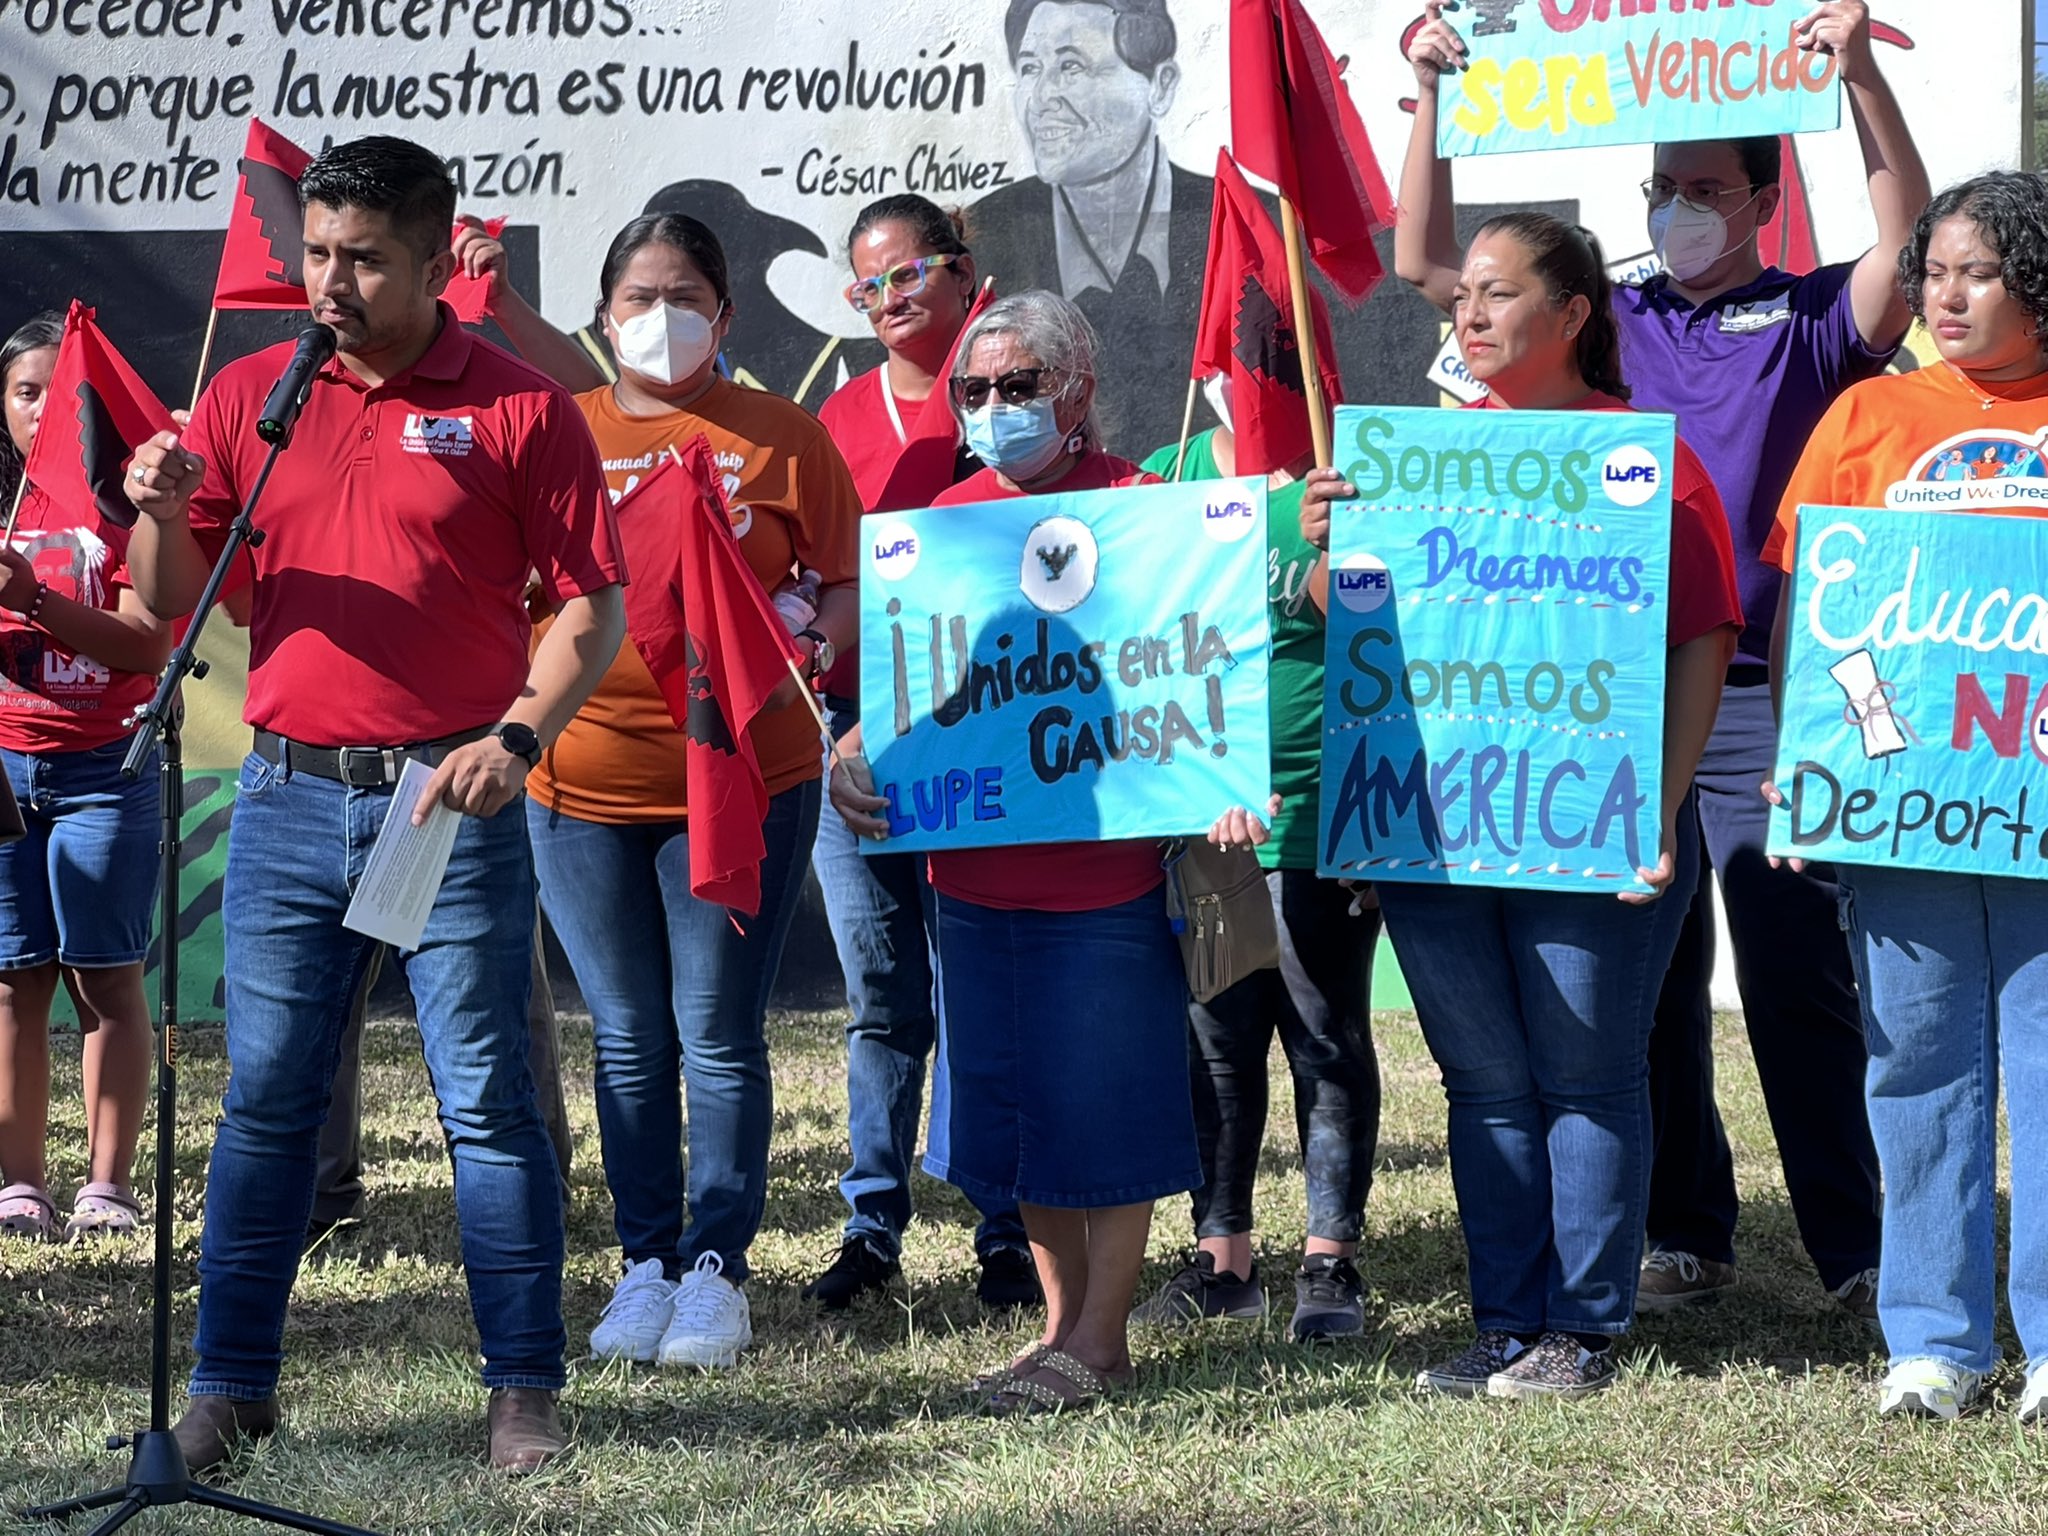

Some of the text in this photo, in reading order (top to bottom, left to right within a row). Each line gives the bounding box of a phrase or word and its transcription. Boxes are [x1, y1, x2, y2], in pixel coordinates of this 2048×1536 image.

[40, 73, 254, 150] porque
[273, 48, 324, 118] la
[333, 46, 540, 121] nuestra
[558, 62, 626, 116] es
[637, 64, 724, 116] una
[737, 39, 986, 115] revolución
[58, 135, 221, 205] mente
[795, 147, 896, 196] César
[905, 142, 1015, 194] Chávez
[403, 413, 473, 442] LUPE
[602, 452, 652, 471] nnual
[1345, 416, 1592, 514] Somos
[1606, 464, 1656, 483] LUPE
[1206, 501, 1252, 519] LUPE
[1894, 487, 1961, 503] United
[875, 538, 915, 560] LUPE
[1417, 526, 1656, 610] Dreamers,
[1338, 572, 1387, 590] LUPE
[43, 651, 110, 684] LUPE
[1117, 633, 1174, 688] en
[1339, 627, 1616, 725] Somos
[884, 767, 1007, 837] LUPE
[1325, 733, 1648, 871] AMERICA
